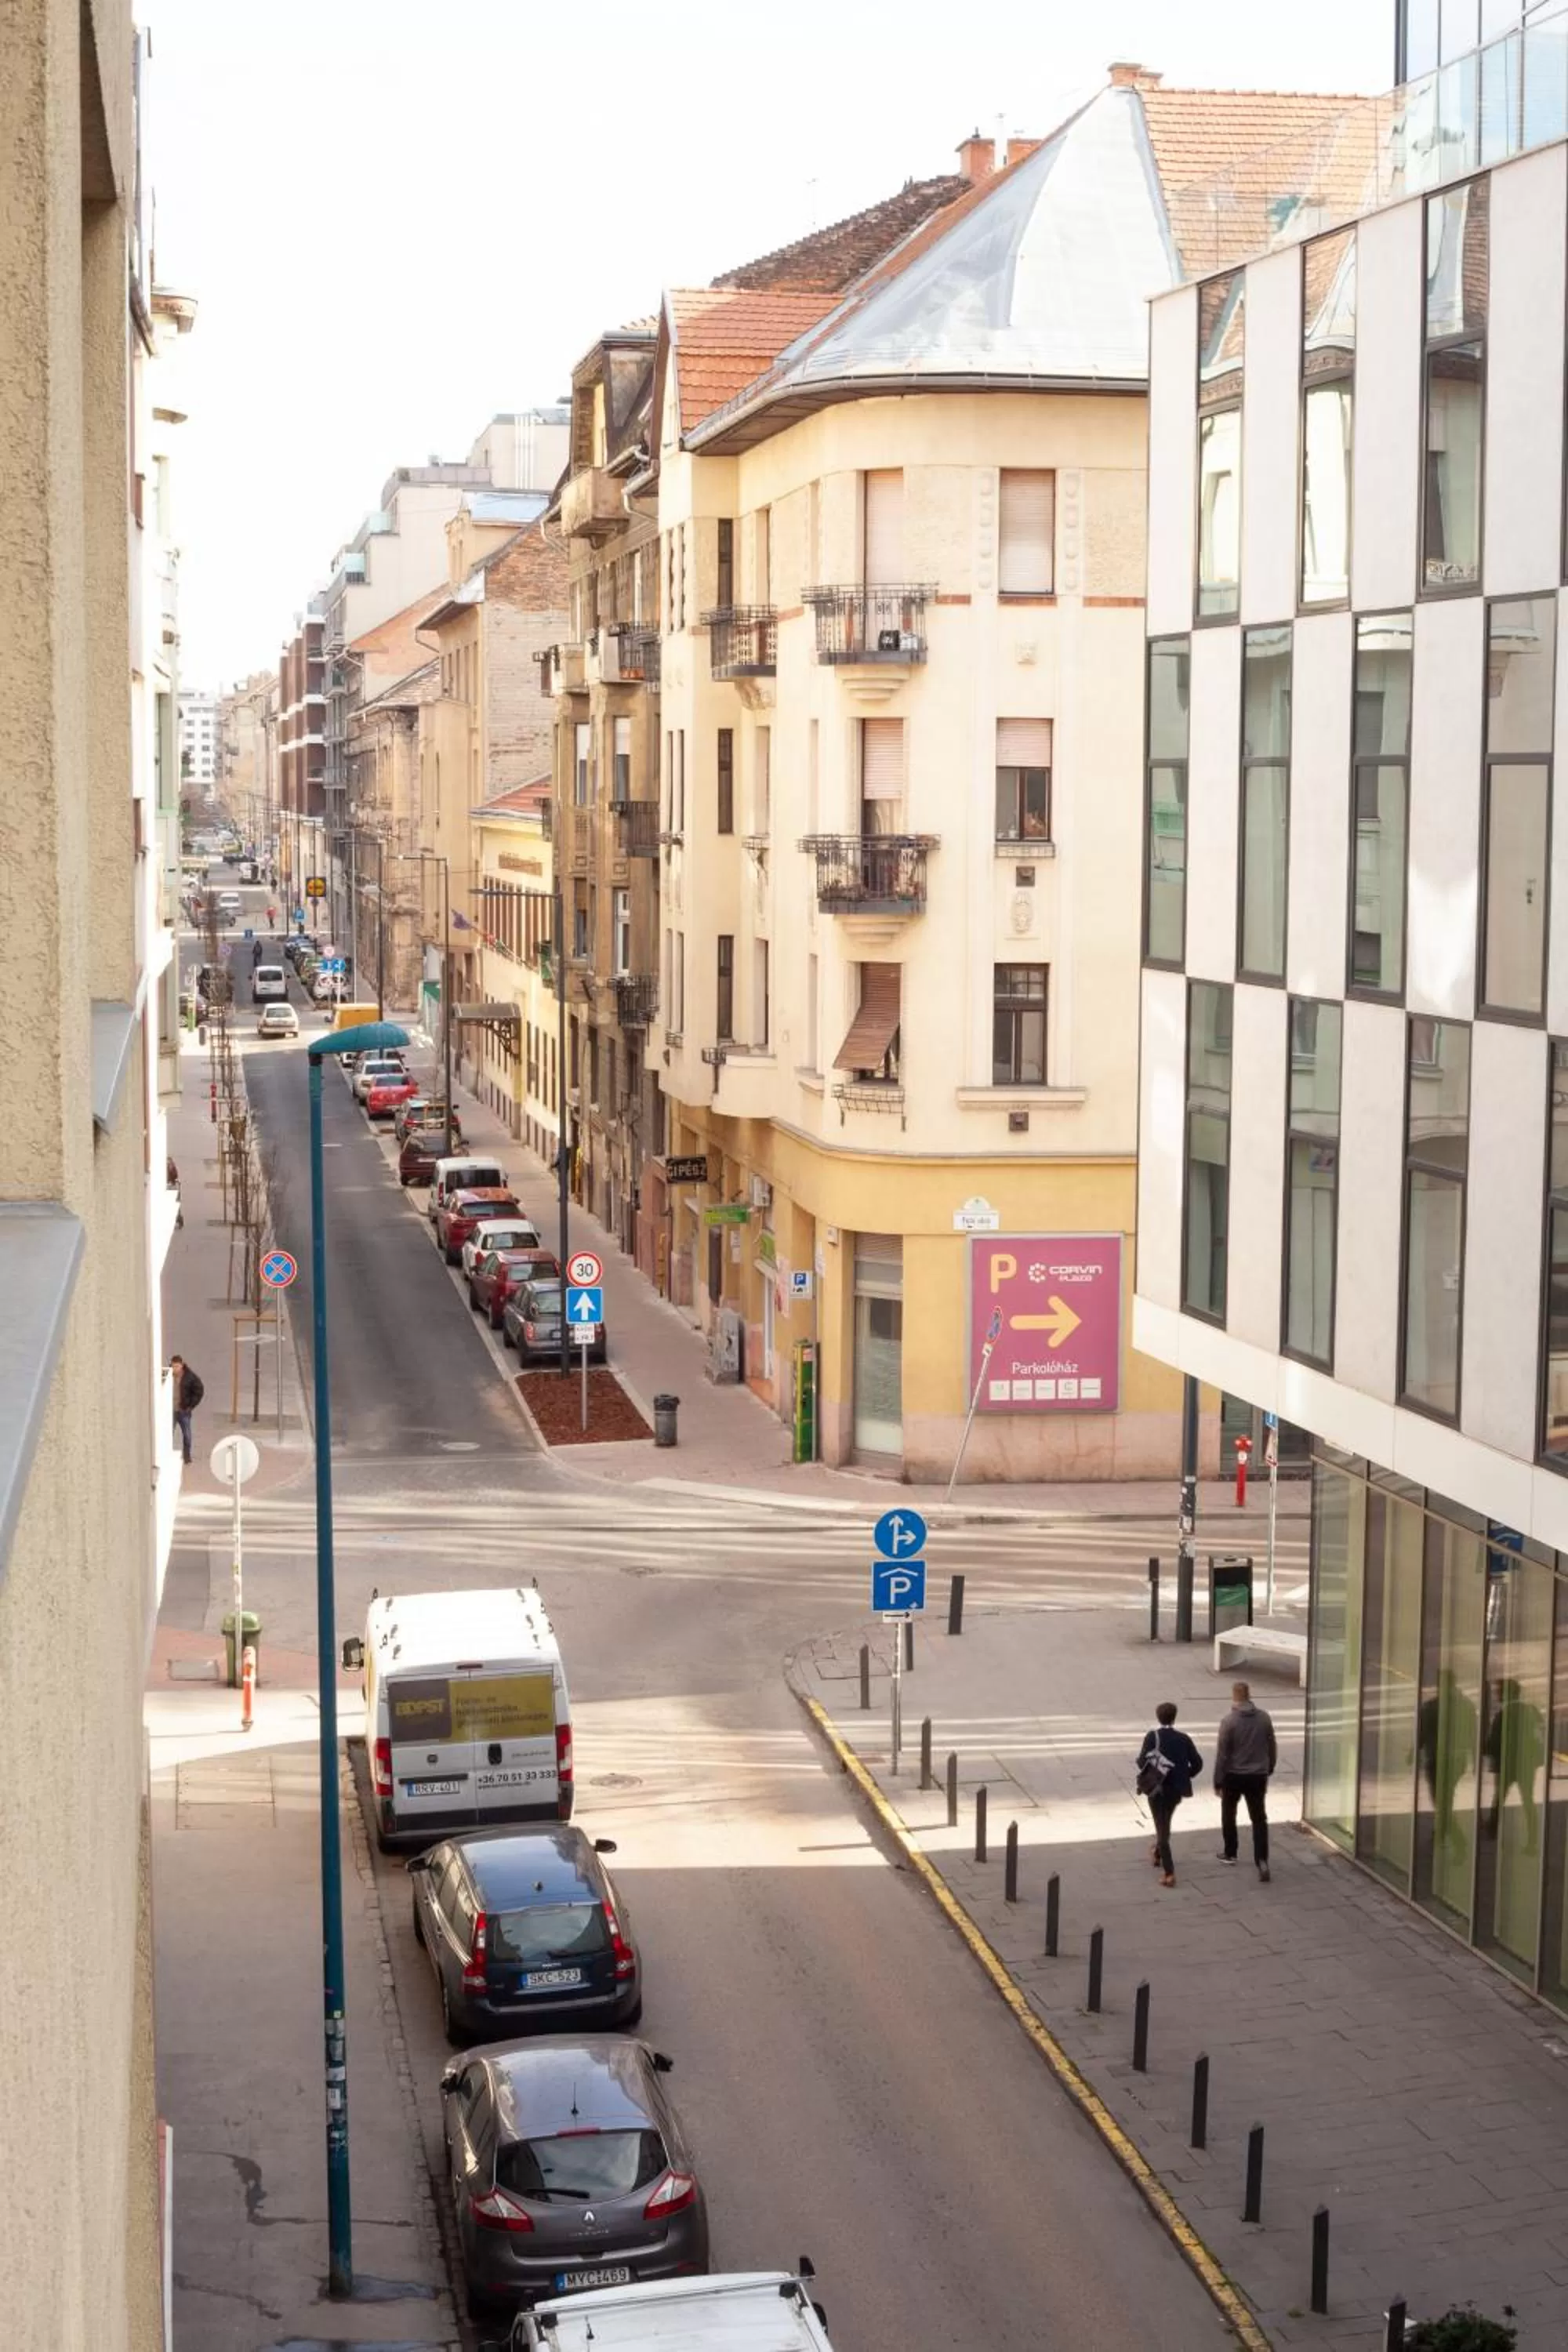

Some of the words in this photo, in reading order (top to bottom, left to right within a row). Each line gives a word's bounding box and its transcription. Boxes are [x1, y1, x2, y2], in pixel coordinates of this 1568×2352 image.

[576, 1262, 593, 1277] 30
[990, 1254, 1017, 1293] P
[1049, 1265, 1102, 1274] CORVIN
[1011, 1360, 1080, 1374] Parkolóház
[890, 1577, 911, 1605] P
[477, 1774, 495, 1784] +36
[498, 1773, 509, 1783] 70
[512, 1772, 522, 1781] 51
[526, 1770, 537, 1780] 33
